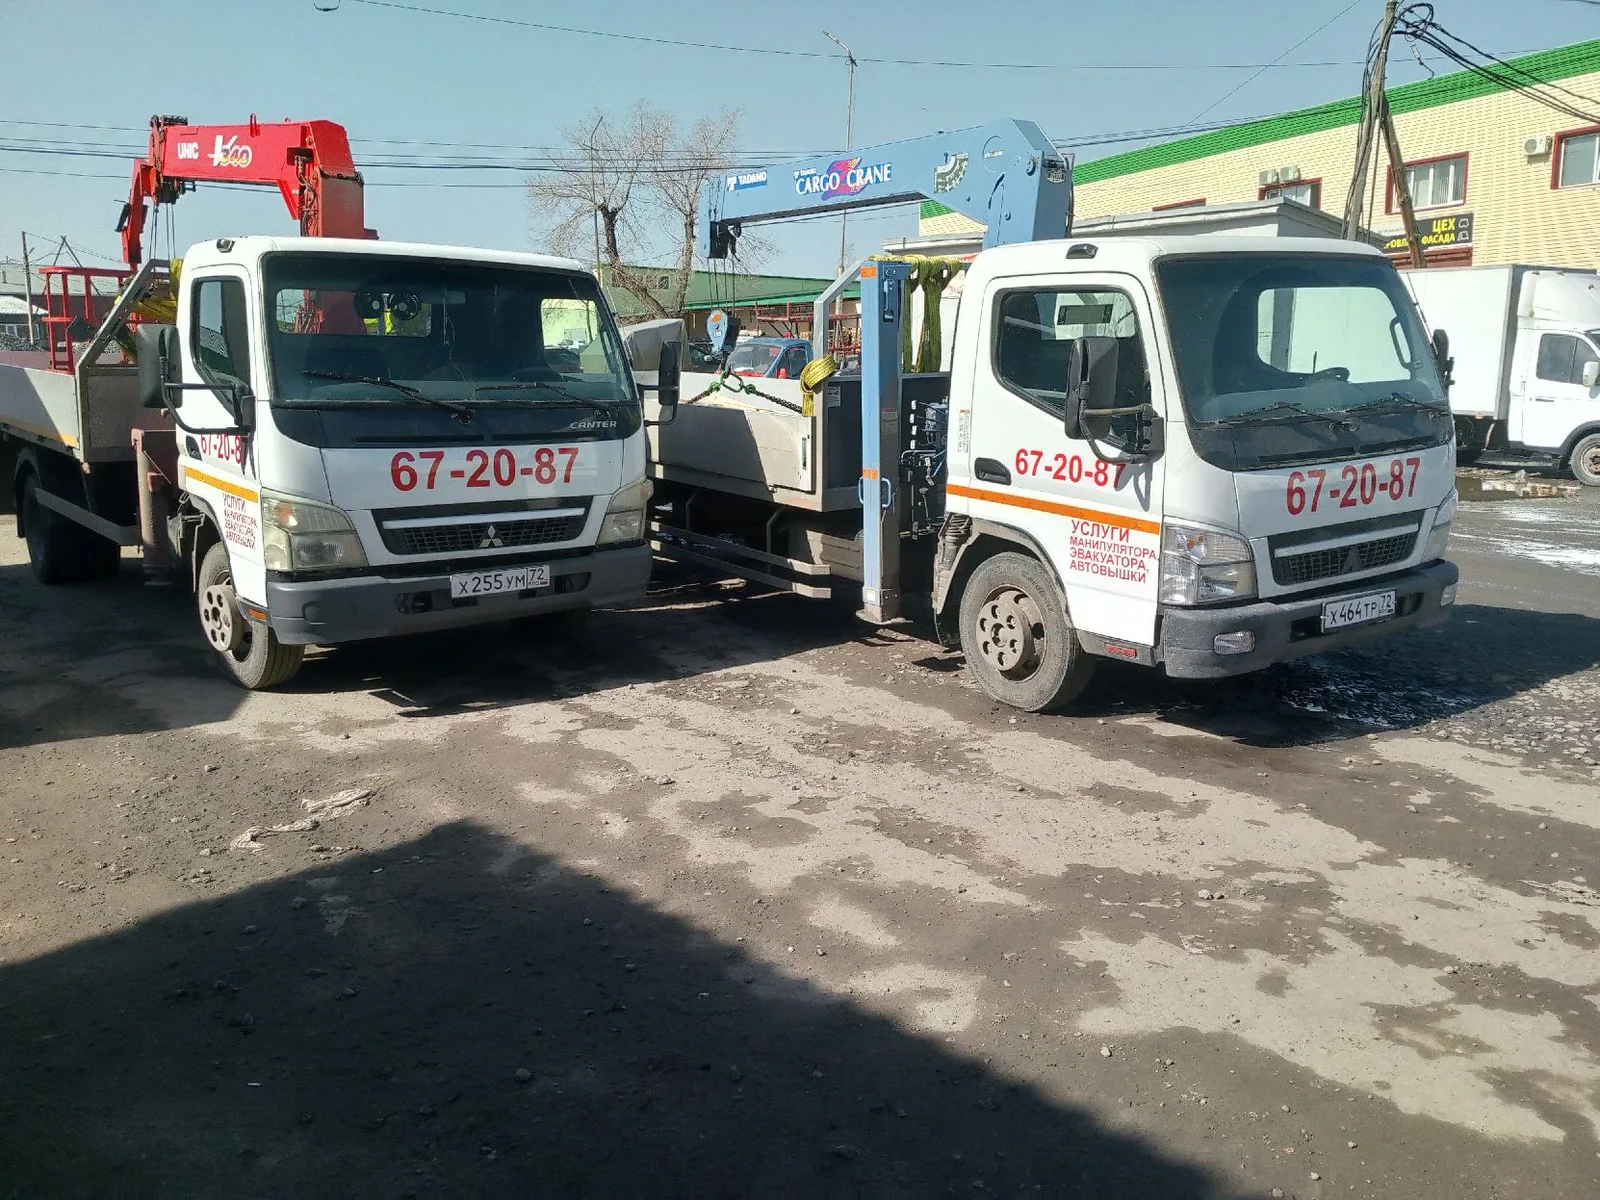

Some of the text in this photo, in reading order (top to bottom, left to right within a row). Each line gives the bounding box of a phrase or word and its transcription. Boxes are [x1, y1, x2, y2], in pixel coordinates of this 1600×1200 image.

[177, 142, 199, 160] UNIC
[738, 171, 767, 186] TADANO
[795, 172, 841, 195] CARGO
[846, 162, 892, 188] CRANE
[1432, 217, 1456, 233] ЦЕХ
[1421, 233, 1456, 245] ФАСАДА
[568, 420, 618, 430] CANTER
[390, 447, 579, 492] 67-20-87
[1015, 448, 1127, 489] 67-20-87
[1286, 457, 1421, 516] 67-20-87
[1071, 519, 1130, 543] УСЛУГИ
[1069, 536, 1159, 562] МАНИПУЛЯТОРА,
[1069, 547, 1149, 572] ЭВАКУАТОРА,
[1069, 559, 1146, 584] АВТОВЫШКИ
